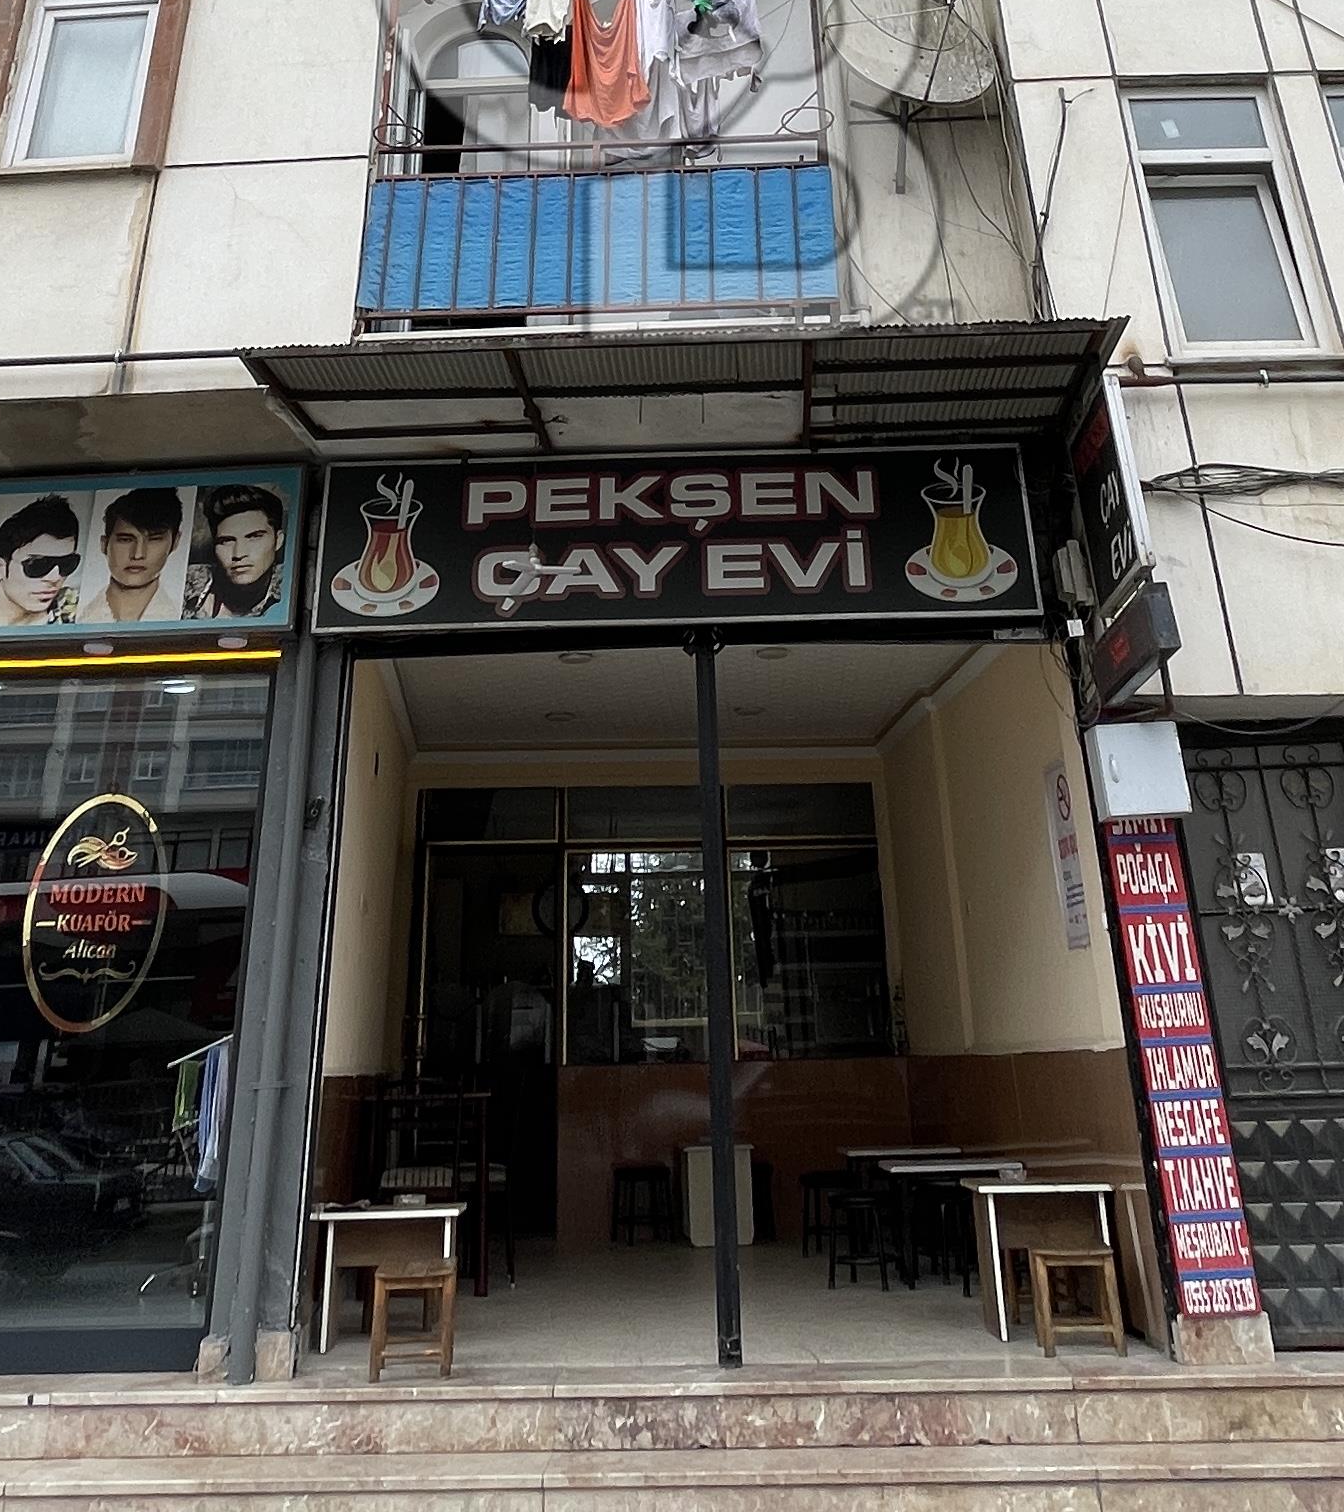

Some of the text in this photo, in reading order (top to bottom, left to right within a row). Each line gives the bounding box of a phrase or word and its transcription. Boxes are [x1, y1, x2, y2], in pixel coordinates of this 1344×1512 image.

[466, 470, 875, 531] PEKŞEN
[477, 529, 867, 611] ÇAY EVİ
[49, 882, 147, 905] MODERN
[1115, 842, 1179, 904] POĞAÇA
[56, 910, 132, 933] KUAFÖR
[62, 939, 118, 960] Alican
[1127, 914, 1198, 985] KİVİ
[1137, 991, 1206, 1038] KUŞBURNU
[1145, 1044, 1218, 1091] IHLAMUR
[1153, 1098, 1226, 1148] NESCAFE
[1163, 1156, 1241, 1212] T.KAHVE
[1173, 1220, 1236, 1268] MEŞRUBAT
